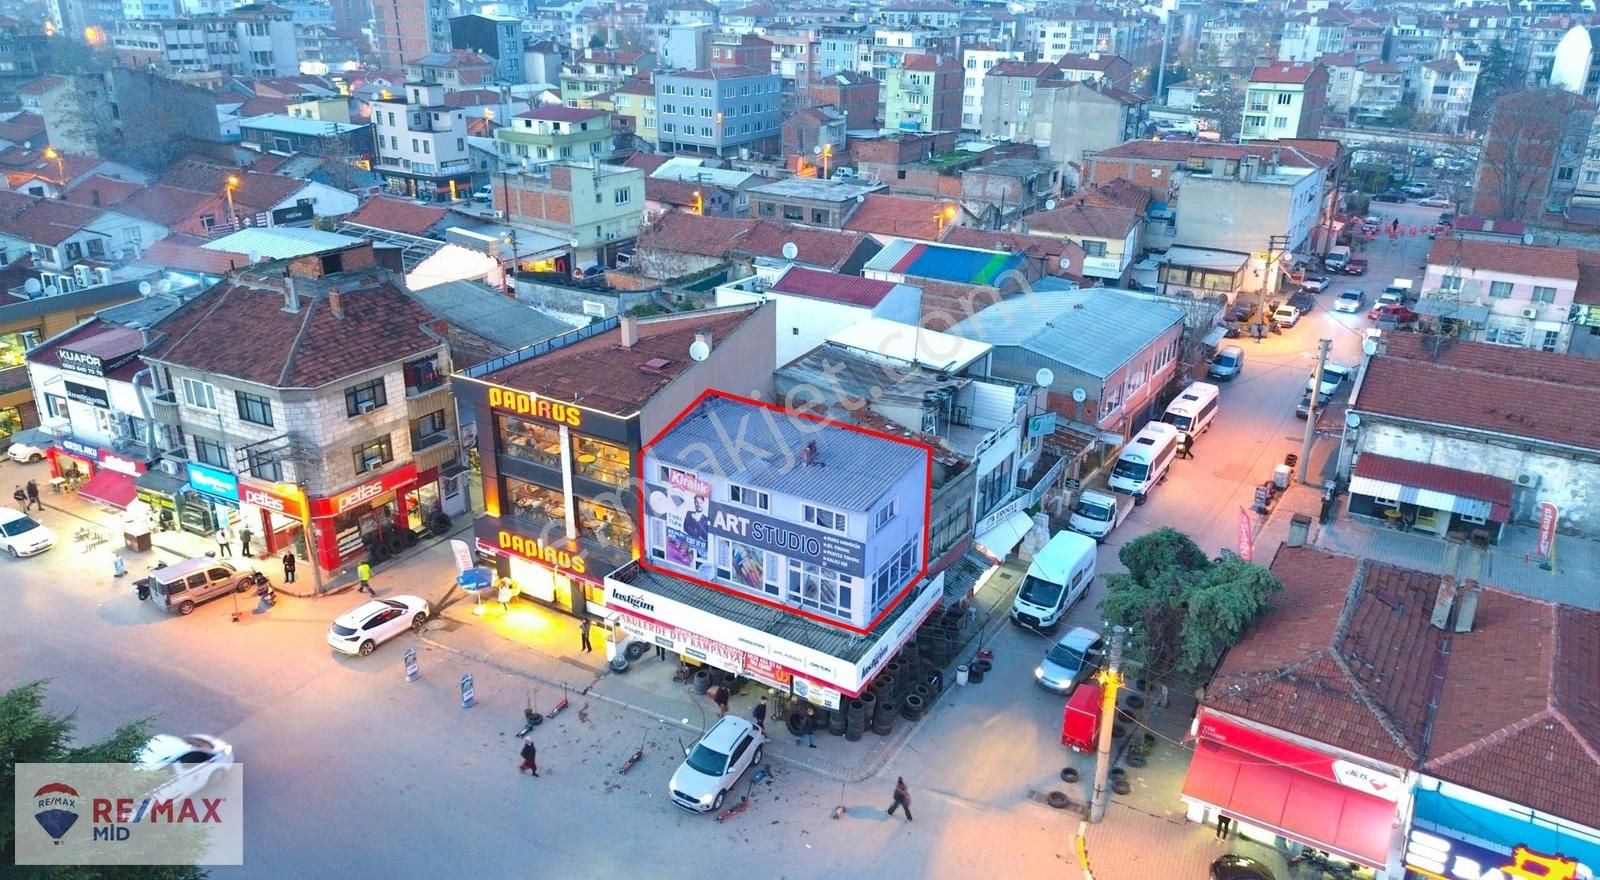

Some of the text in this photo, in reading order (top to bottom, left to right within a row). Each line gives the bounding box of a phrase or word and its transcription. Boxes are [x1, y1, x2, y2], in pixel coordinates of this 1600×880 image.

[59, 349, 101, 367] KUAFÖR
[245, 490, 284, 512] petlas
[338, 481, 383, 513] petlas
[713, 510, 750, 537] ART
[752, 520, 821, 557] STUDIO
